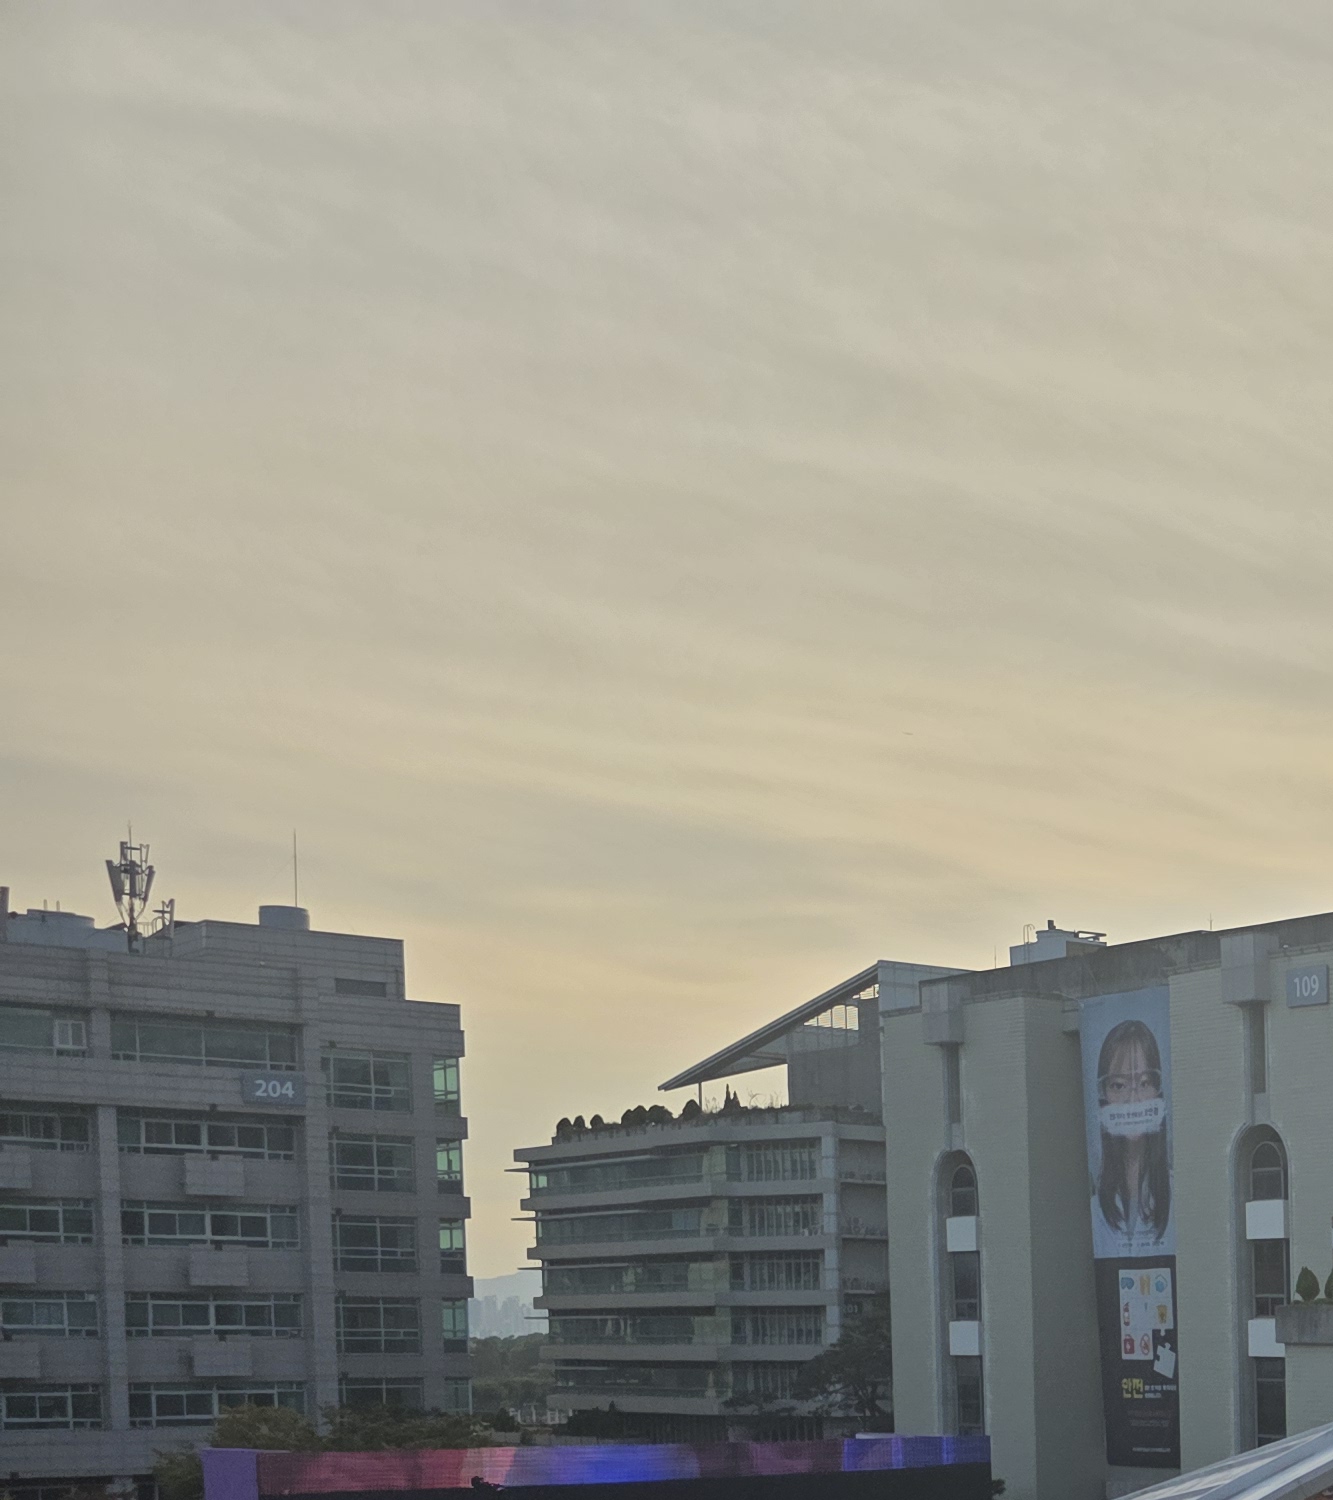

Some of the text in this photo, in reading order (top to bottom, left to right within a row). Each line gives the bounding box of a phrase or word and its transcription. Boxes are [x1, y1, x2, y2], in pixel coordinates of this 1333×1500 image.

[1293, 975, 1319, 997] 109
[254, 1079, 295, 1098] 204
[1121, 1378, 1143, 1399] 안전
